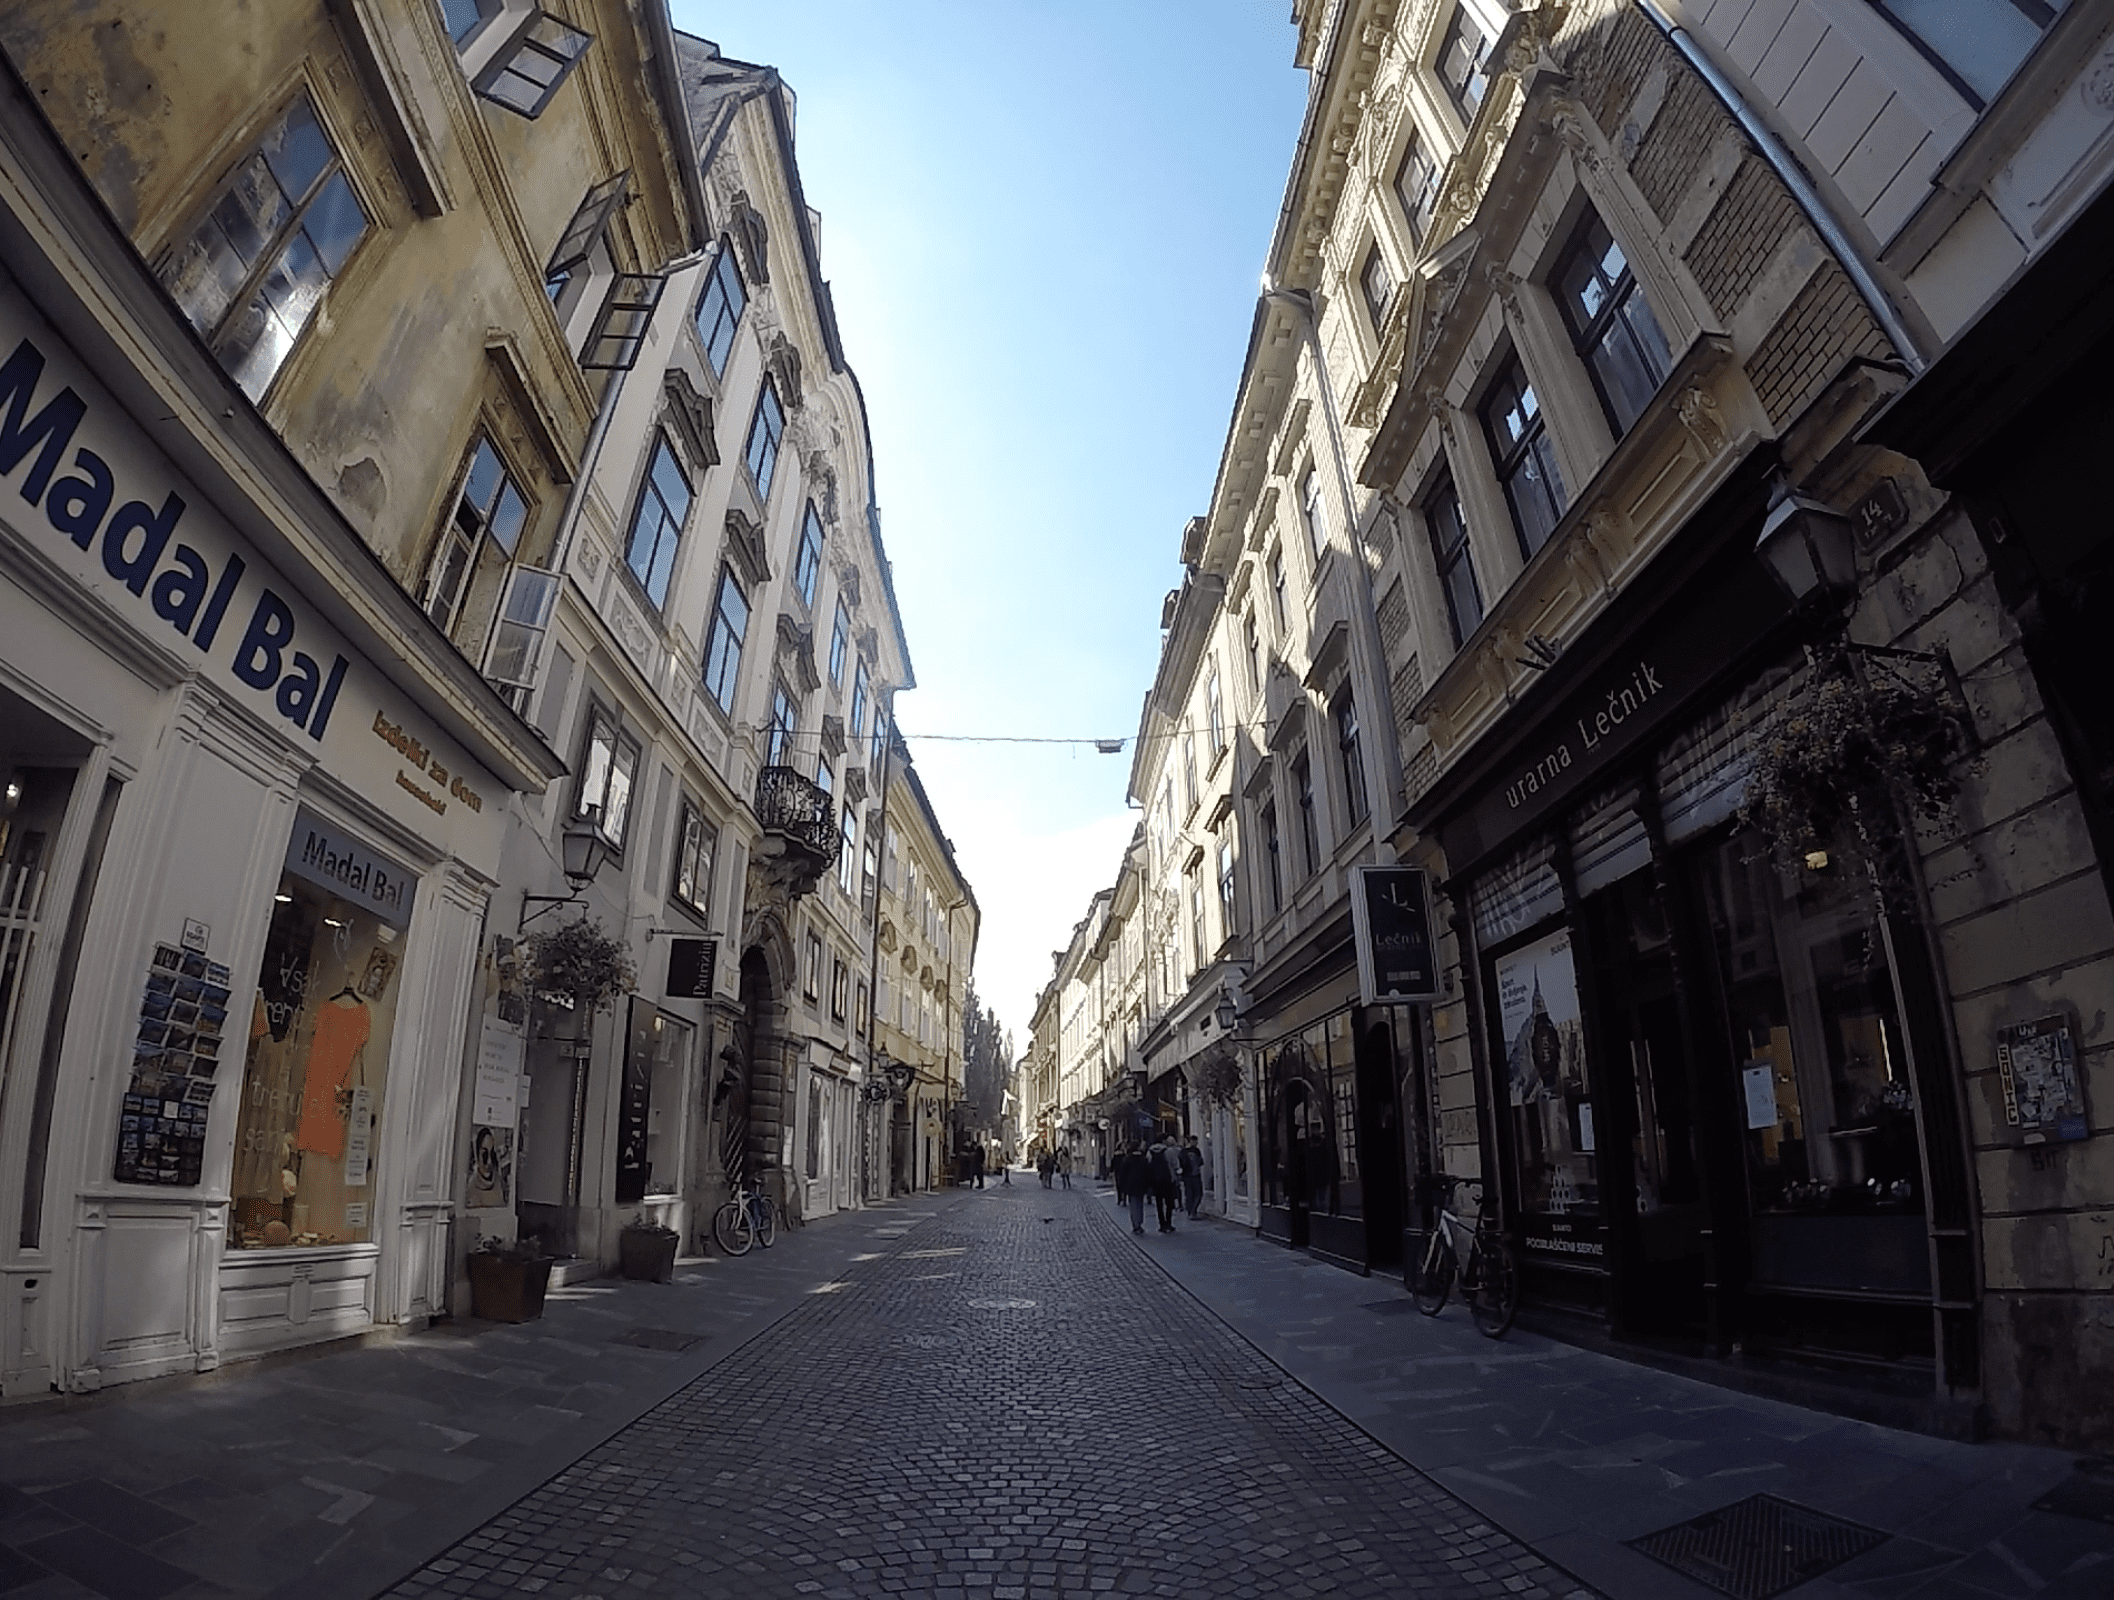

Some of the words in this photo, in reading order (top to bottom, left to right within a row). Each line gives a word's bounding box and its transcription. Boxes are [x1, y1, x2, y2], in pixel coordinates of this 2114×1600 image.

[0, 338, 246, 653] Madal
[231, 588, 349, 742] Bal
[428, 761, 449, 787] za
[450, 776, 482, 813] dom
[1505, 743, 1573, 809] urarna
[1577, 661, 1664, 750] Lečnik
[302, 831, 371, 894] Madal
[372, 869, 404, 911] Bal
